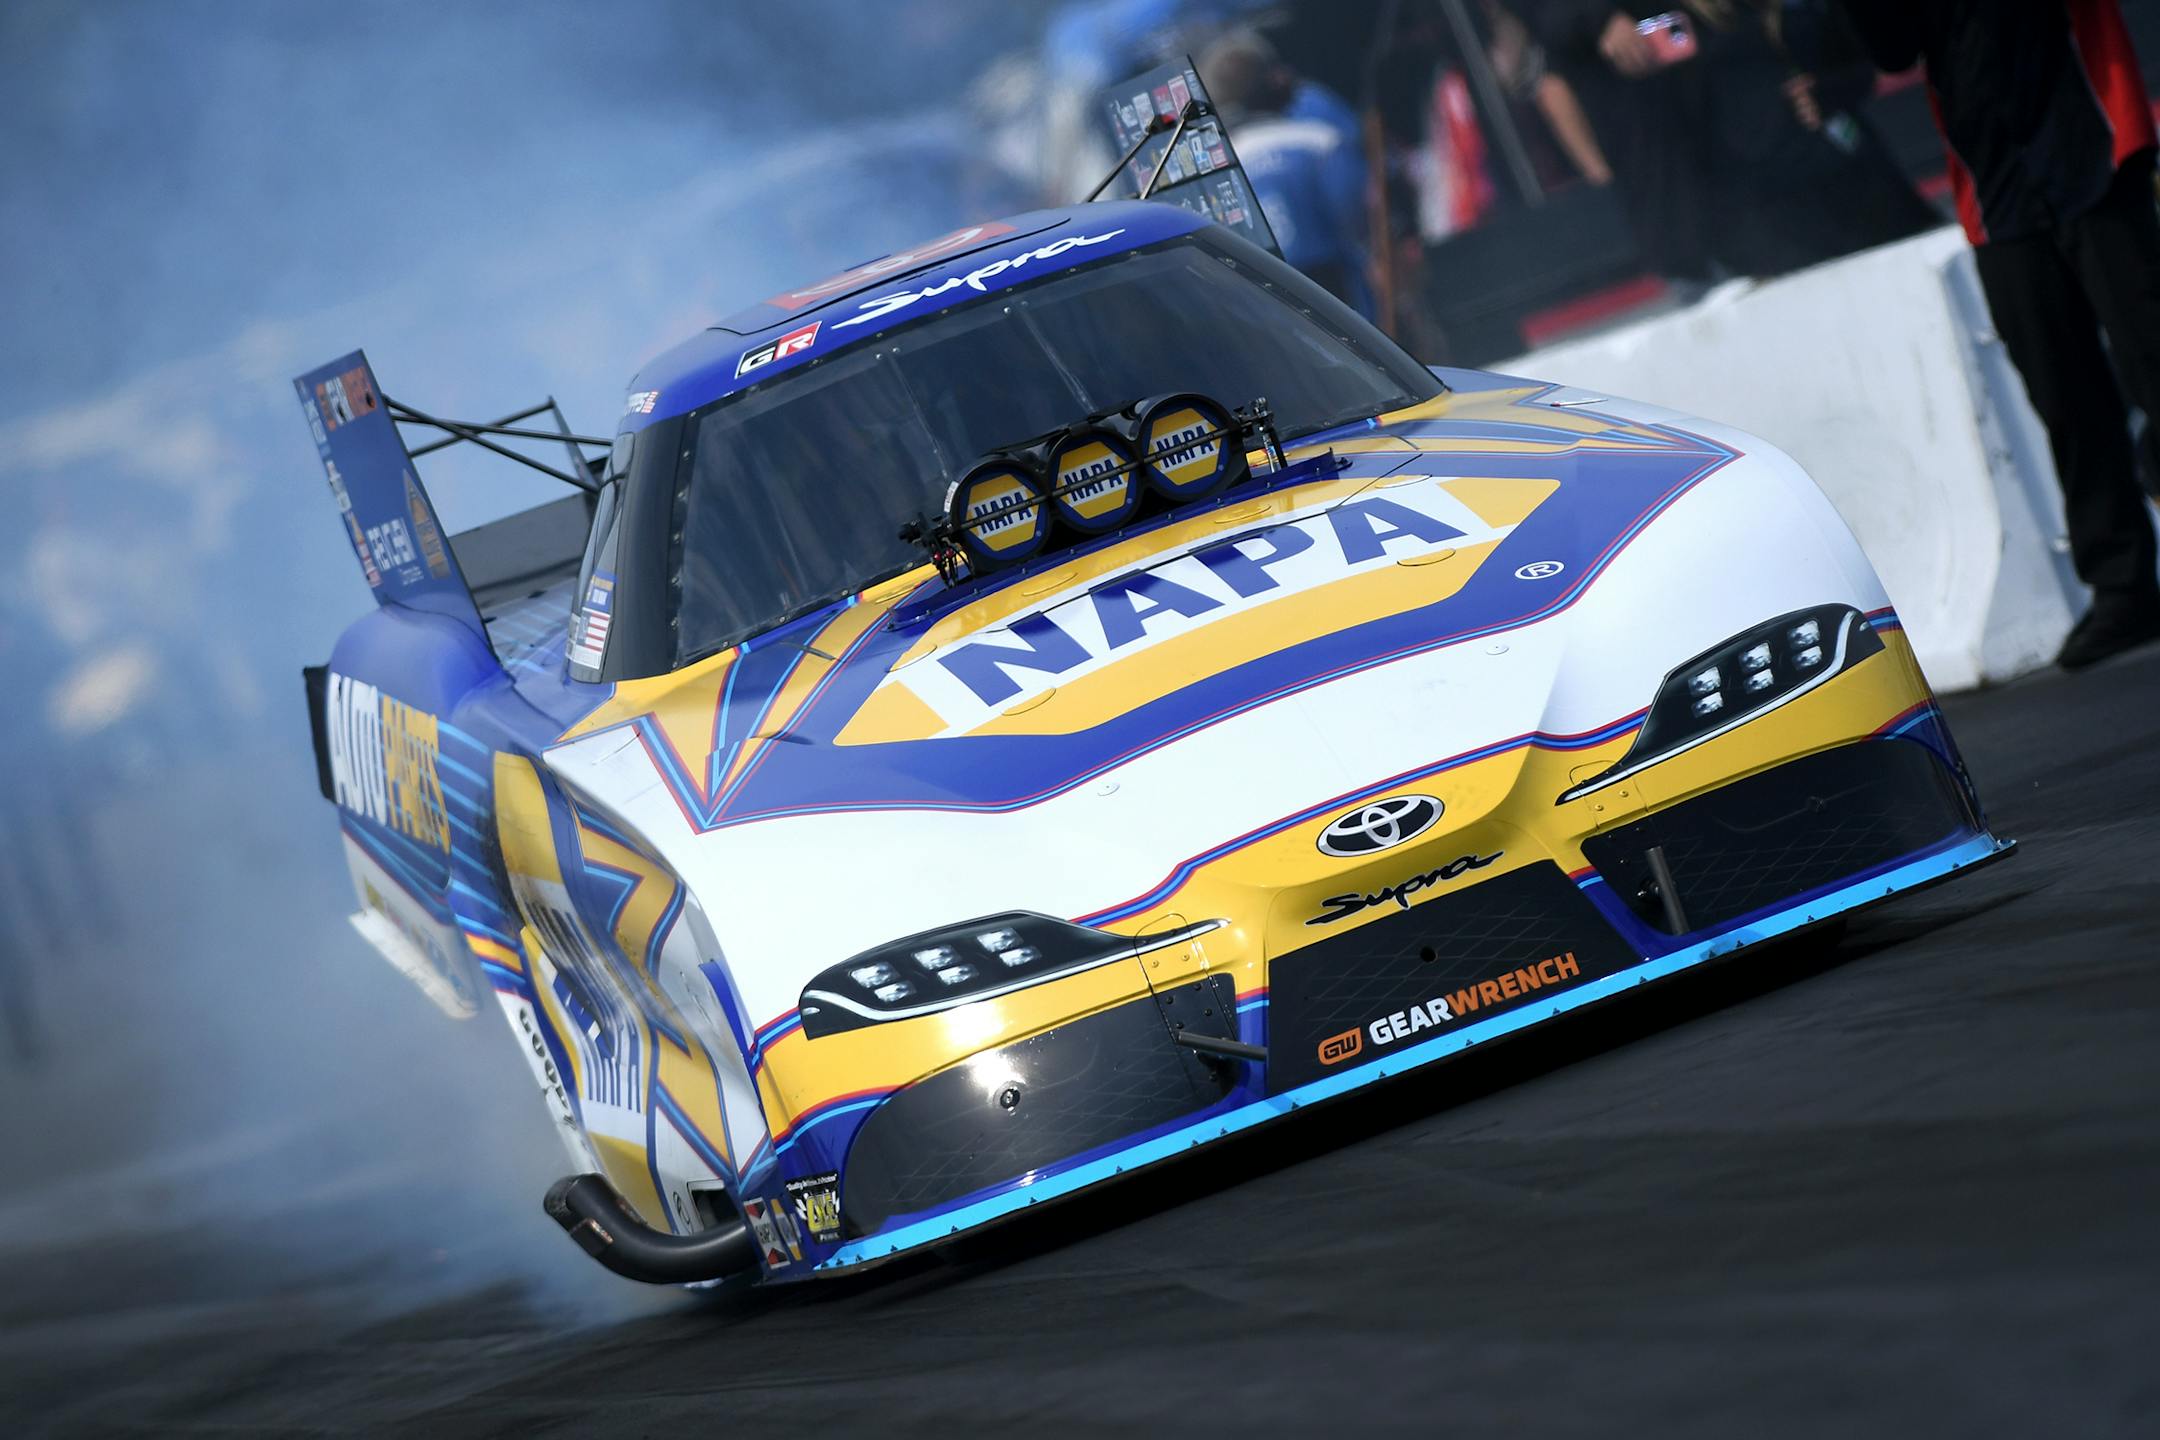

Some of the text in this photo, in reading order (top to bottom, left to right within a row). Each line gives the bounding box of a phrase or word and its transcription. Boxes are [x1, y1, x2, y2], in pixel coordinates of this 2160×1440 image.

[831, 229, 1126, 329] Supra
[739, 333, 814, 374] GR
[1064, 459, 1124, 502] NAPA
[1156, 425, 1216, 468] NAPA
[974, 492, 1032, 533] NAPA
[938, 498, 1467, 707] NAPA
[327, 671, 450, 856] AUTO PARTS
[1304, 851, 1503, 926] Supra
[1323, 952, 1580, 1060] GW GEARWRENCH
